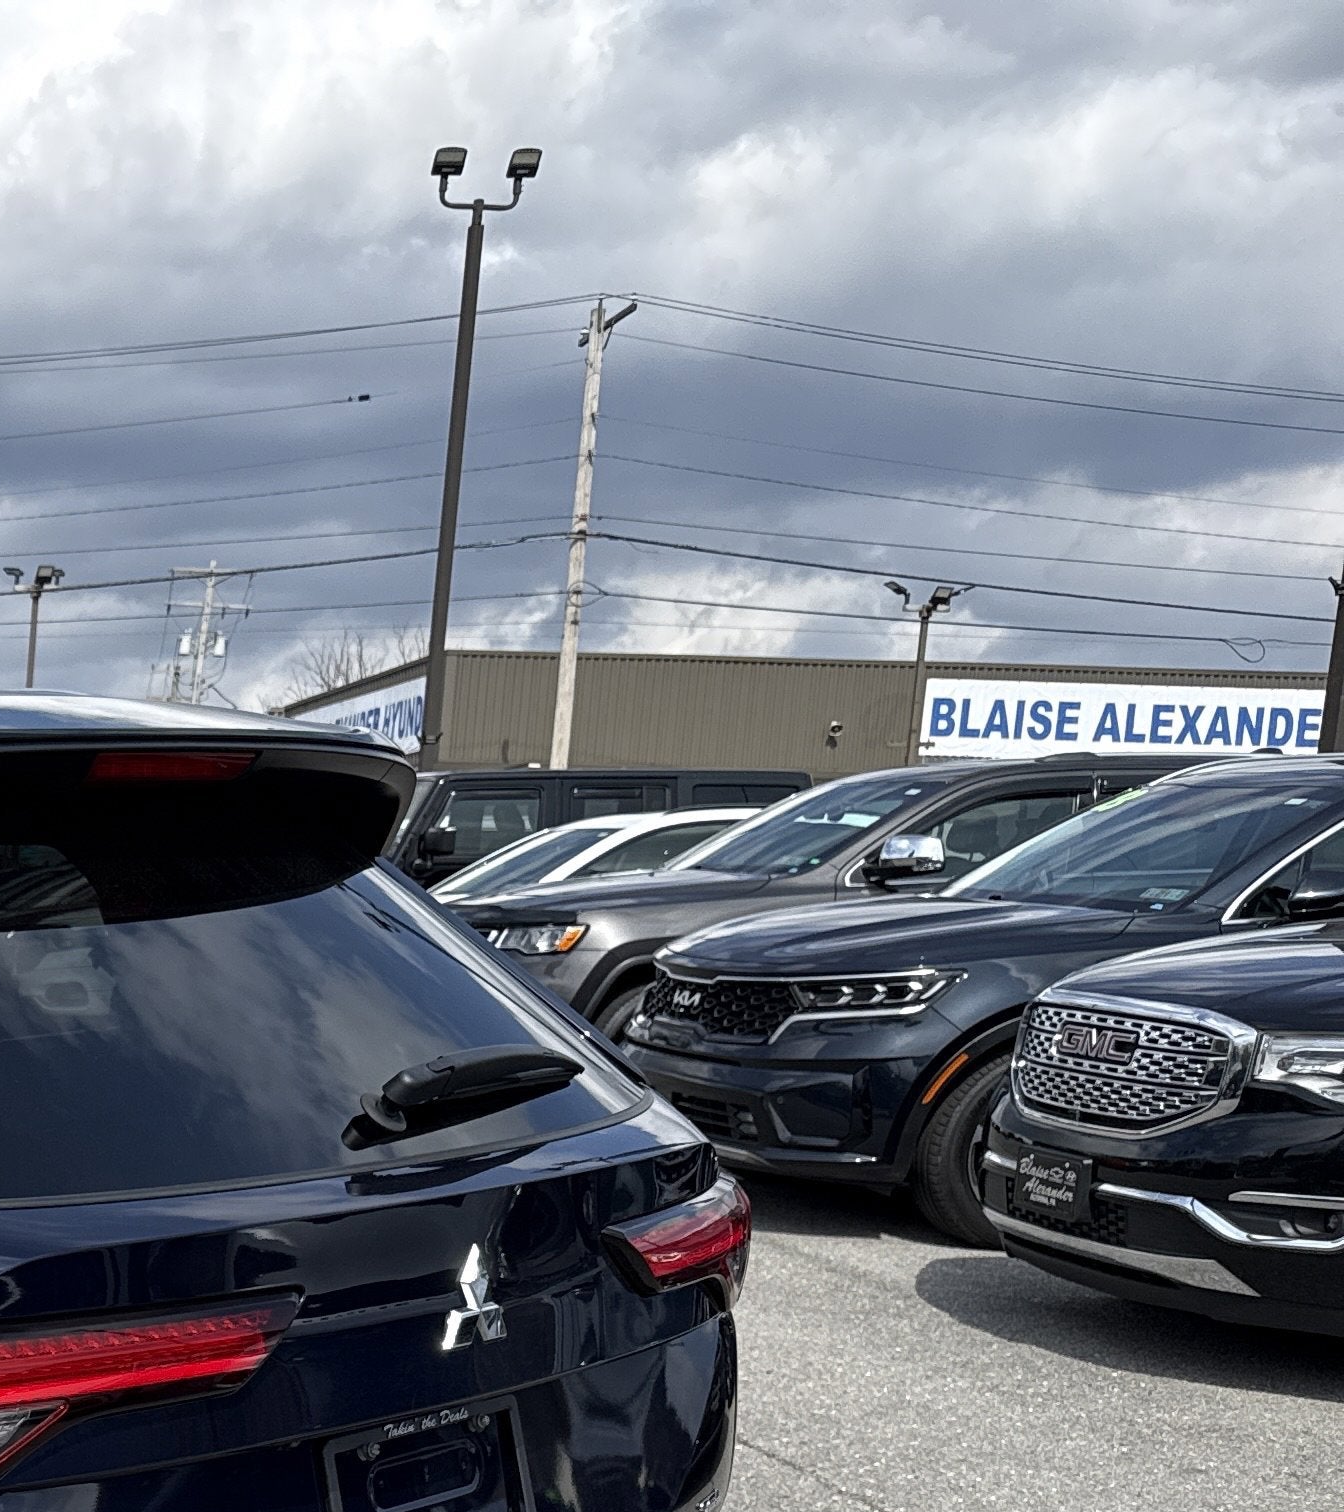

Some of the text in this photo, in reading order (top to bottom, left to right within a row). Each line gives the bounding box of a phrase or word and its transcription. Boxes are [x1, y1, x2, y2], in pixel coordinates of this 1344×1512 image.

[930, 698, 1081, 740] BLAISE
[1060, 1024, 1138, 1065] GMC
[421, 1414, 437, 1431] the
[439, 1407, 469, 1425] Deals
